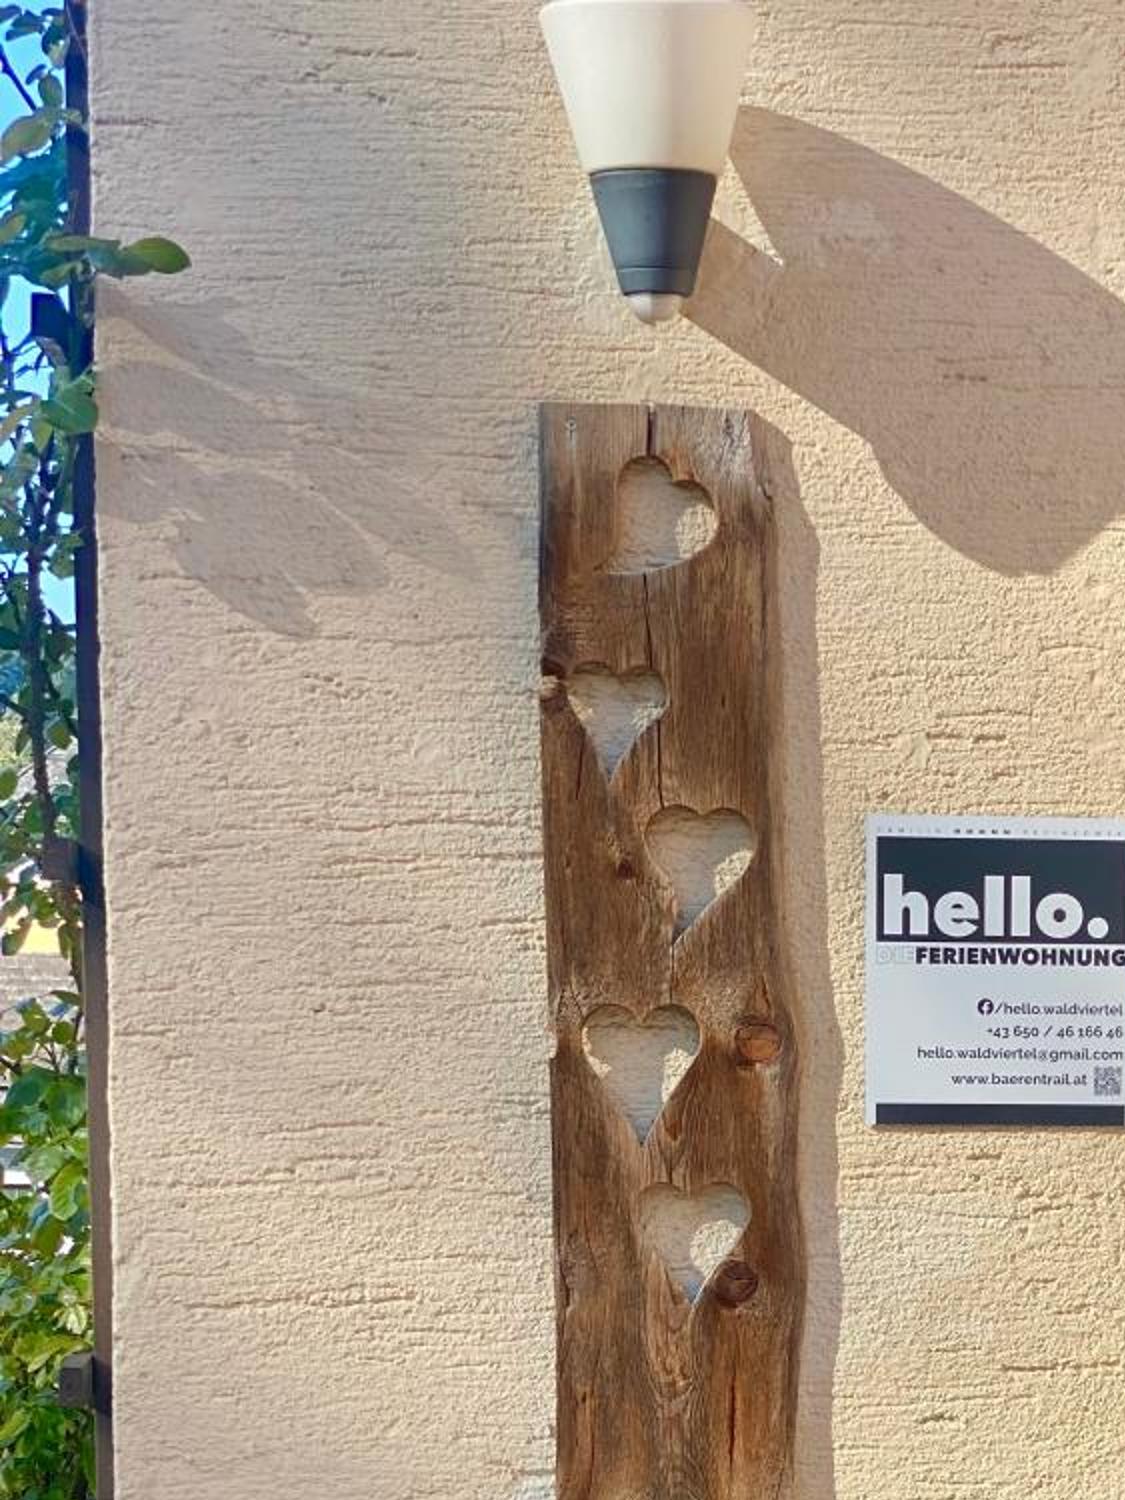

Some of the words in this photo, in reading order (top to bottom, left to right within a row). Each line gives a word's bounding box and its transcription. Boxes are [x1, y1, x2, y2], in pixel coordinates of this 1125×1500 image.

[883, 873, 1109, 939] hello.
[986, 1026, 1009, 1039] +43
[1013, 1025, 1039, 1038] 650
[1056, 1025, 1074, 1039] 46
[1105, 1025, 1123, 1039] 46
[917, 1046, 1123, 1062] hello.waldviertel@gmail.com
[951, 1073, 1087, 1086] www.baerentrail.at
